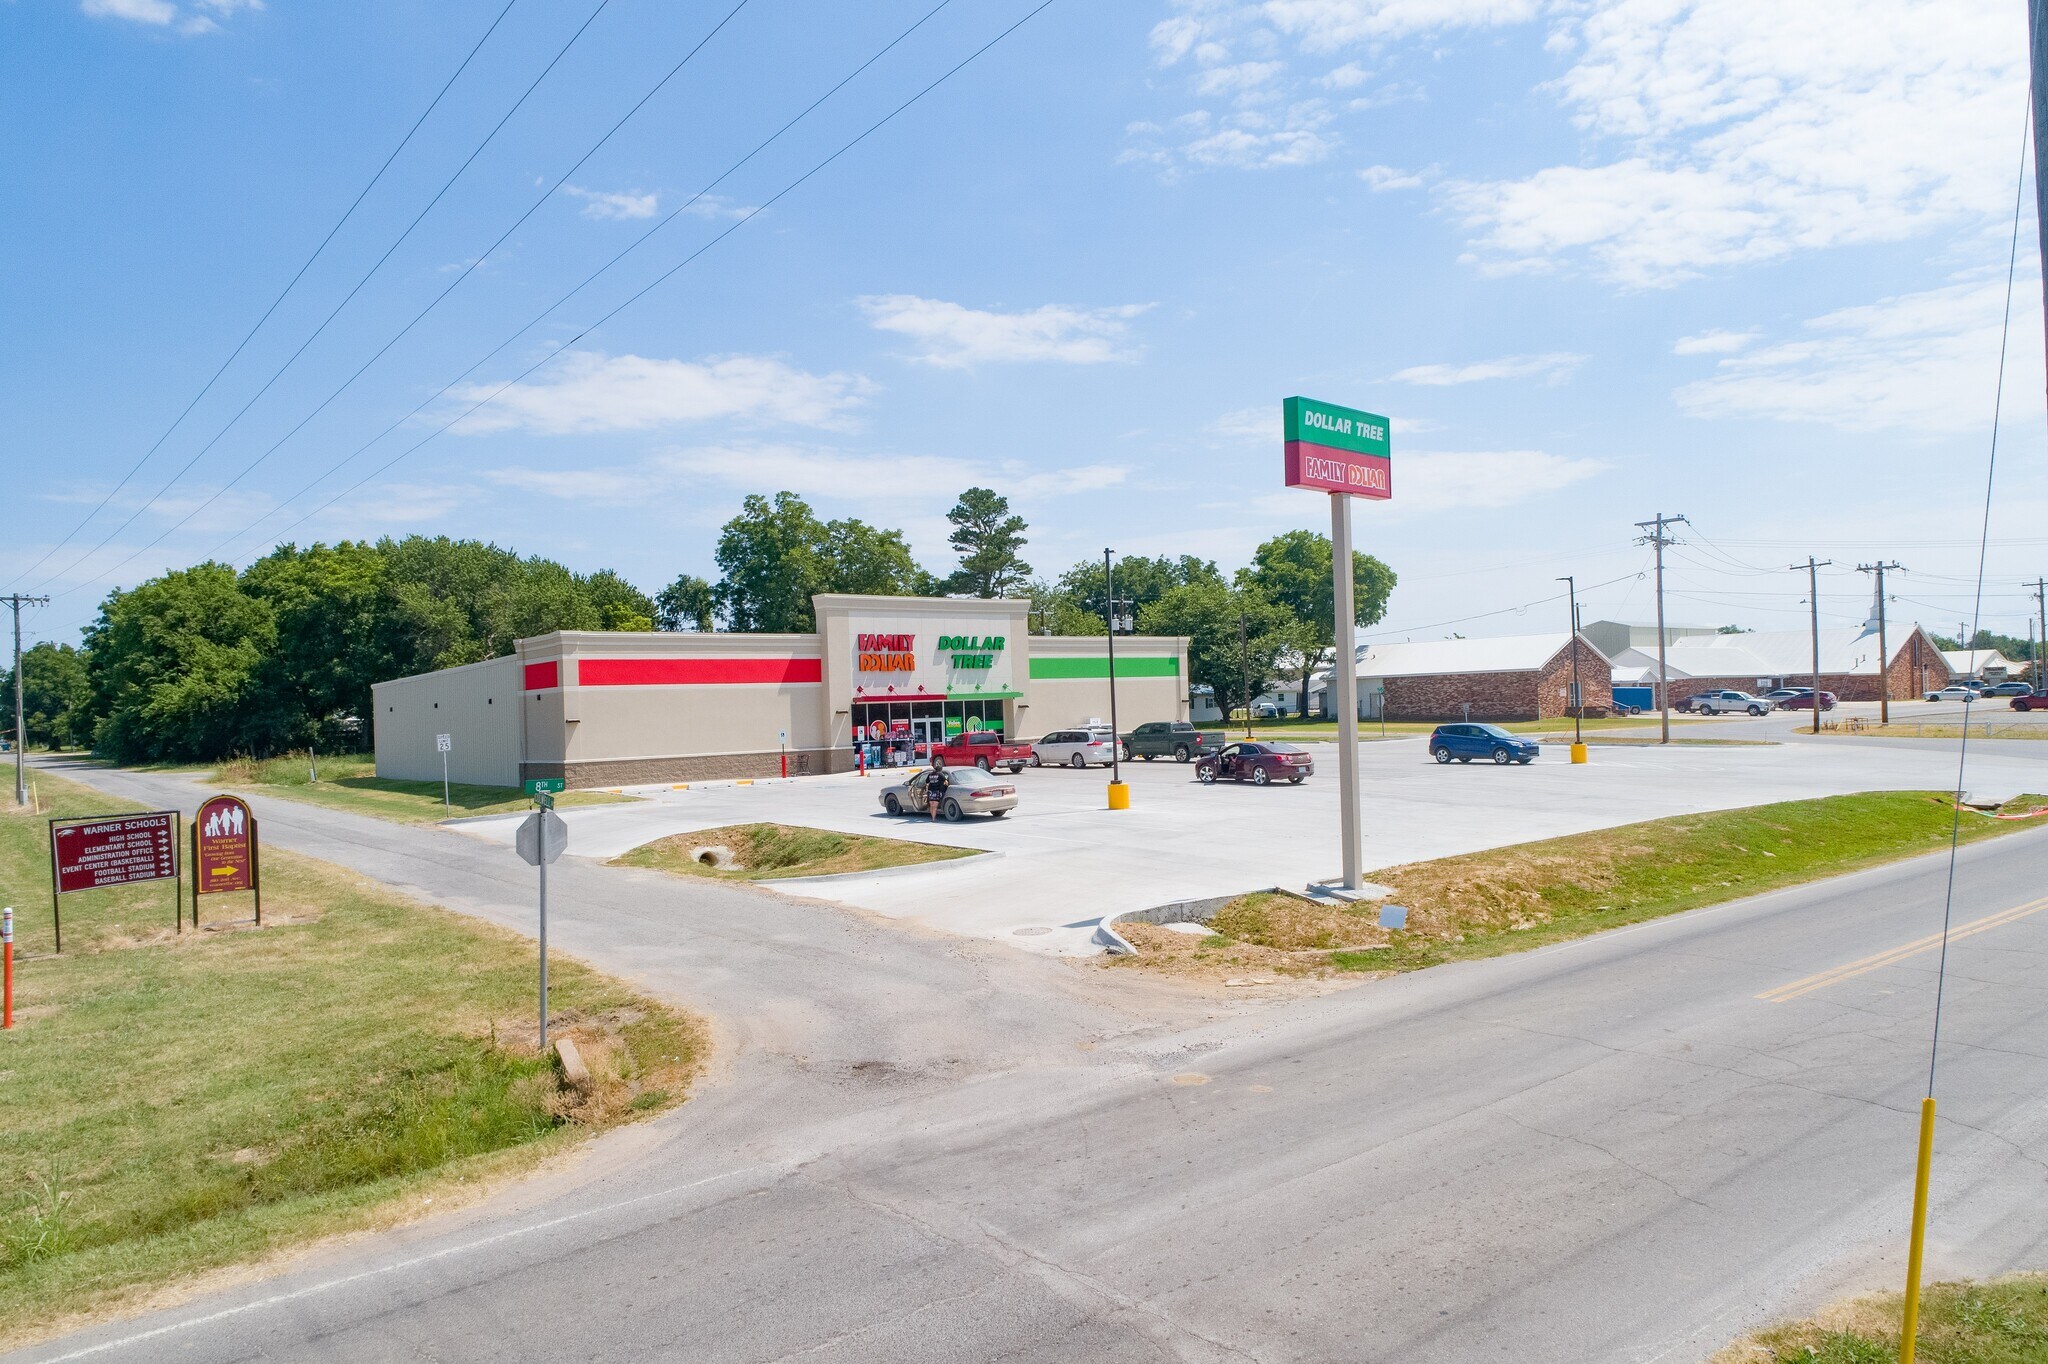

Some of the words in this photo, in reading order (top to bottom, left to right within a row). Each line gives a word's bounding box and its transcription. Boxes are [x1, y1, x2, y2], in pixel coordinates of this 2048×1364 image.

[1304, 410, 1352, 434] DOLLAR
[1355, 421, 1384, 441] TREE
[1306, 457, 1346, 483] FAMILY
[1348, 464, 1386, 490] DOLLAR
[857, 633, 916, 652] FAMILY
[938, 635, 1006, 651] DOLLAR
[858, 653, 916, 672] DOLLAR
[951, 654, 994, 669] TREE
[535, 781, 548, 792] 8TH
[84, 824, 121, 835] WARNER
[125, 818, 167, 829] SCHOOLS
[127, 831, 152, 841] SCHOOL
[78, 850, 130, 863] ADMINISTRATION
[131, 847, 154, 856] OFFICE
[84, 844, 125, 854] ELEMENTARY
[127, 840, 152, 849] SCHOOL
[62, 865, 83, 874] EVENT
[84, 862, 109, 871] CENTER
[110, 856, 155, 868] (BASKETBALL)
[94, 868, 127, 877] FOOTBALL
[128, 863, 155, 873] STADIUM
[95, 875, 127, 885] BASEBALL
[128, 870, 156, 880] STADIUM
